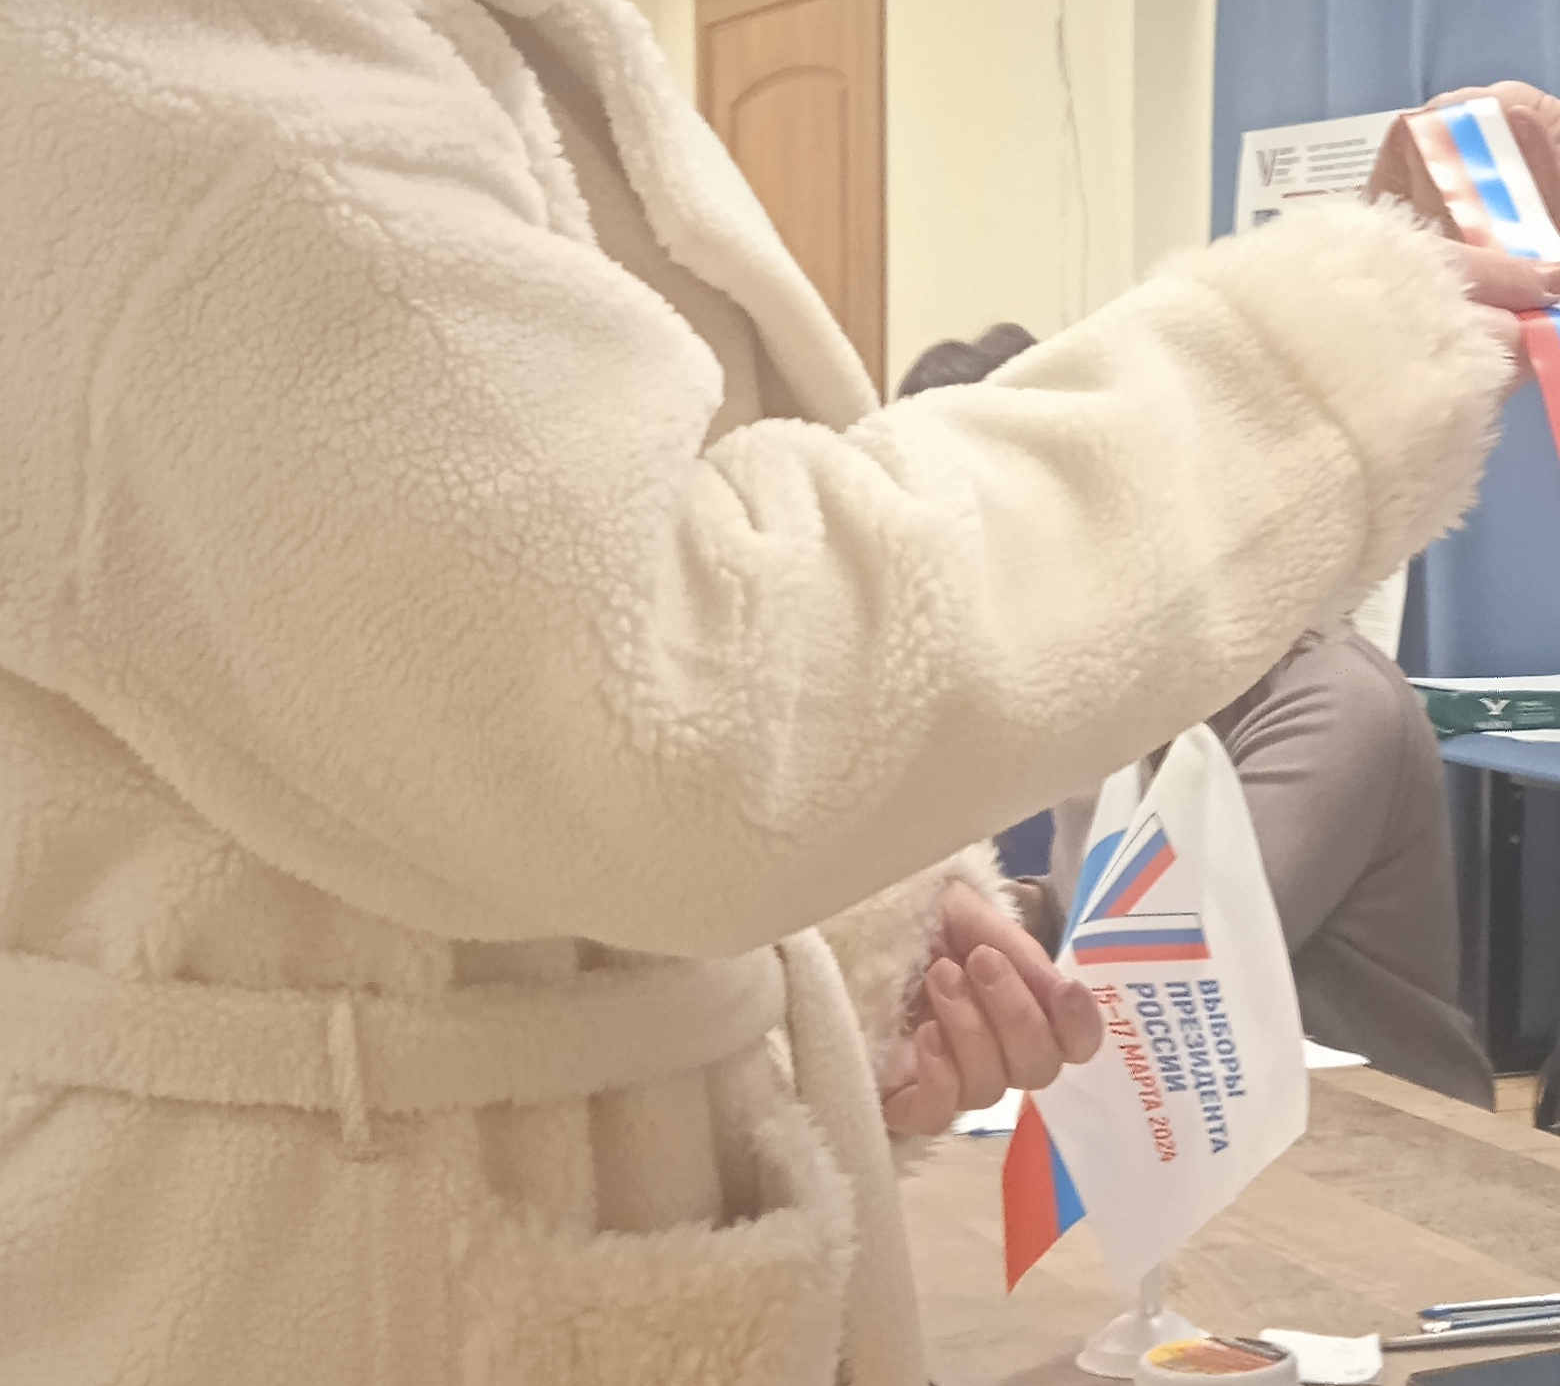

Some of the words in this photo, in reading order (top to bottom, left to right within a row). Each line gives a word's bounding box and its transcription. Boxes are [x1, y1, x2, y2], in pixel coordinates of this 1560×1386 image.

[1126, 982, 1188, 1092] РОССИИ
[1165, 981, 1229, 1154] ПРЕЗИДЕНТА
[1197, 979, 1246, 1098] ВЫБОРЫ
[1119, 1043, 1163, 1112] МАРТА
[1147, 1116, 1177, 1163] 2024
